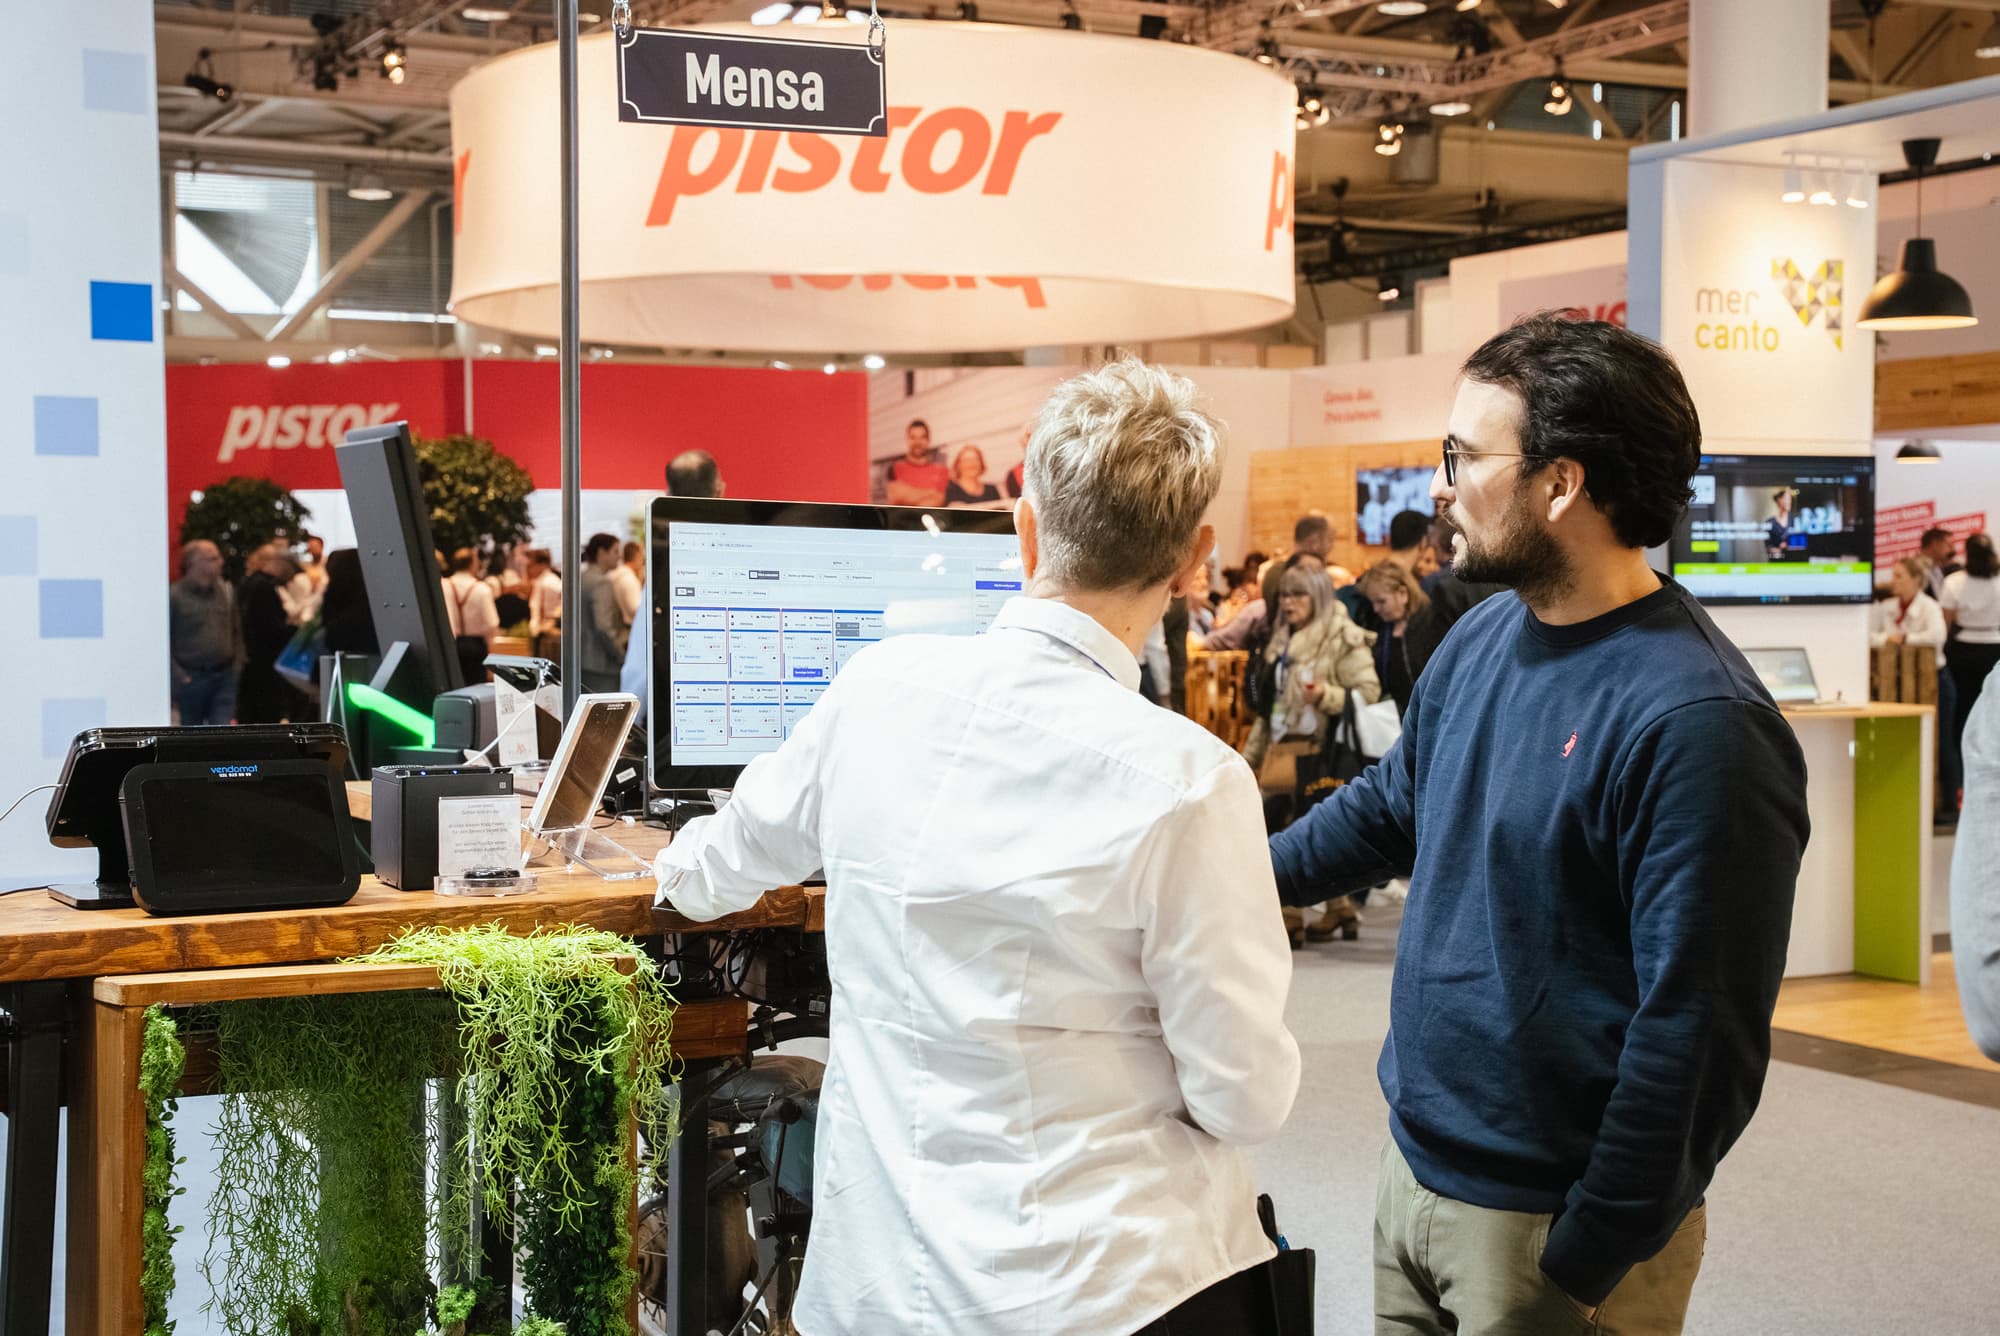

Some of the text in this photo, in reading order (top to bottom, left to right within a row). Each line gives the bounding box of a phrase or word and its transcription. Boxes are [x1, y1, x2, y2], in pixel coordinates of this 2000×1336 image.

[685, 52, 825, 112] Mensa
[1696, 287, 1760, 314] mer
[1695, 320, 1780, 352] canto
